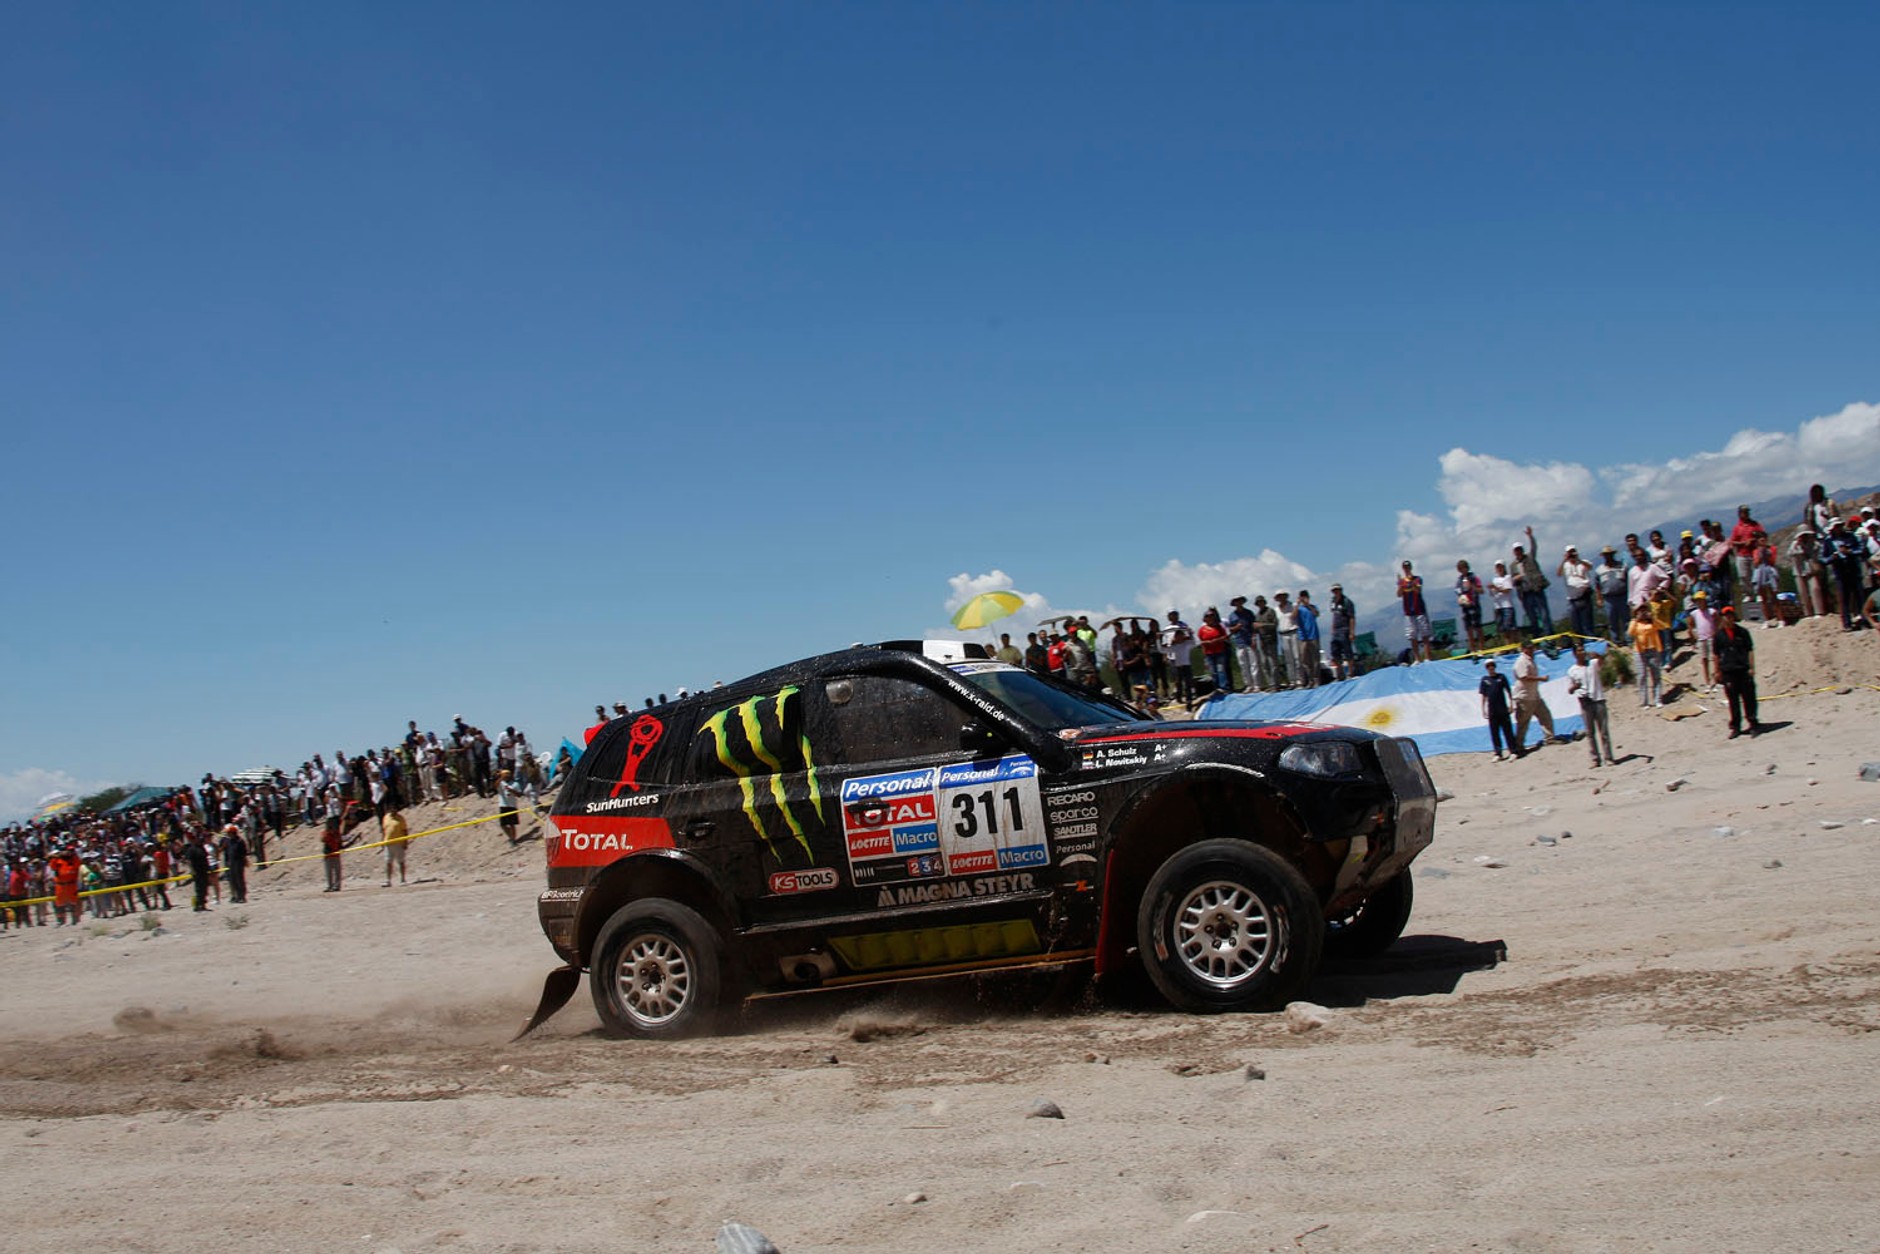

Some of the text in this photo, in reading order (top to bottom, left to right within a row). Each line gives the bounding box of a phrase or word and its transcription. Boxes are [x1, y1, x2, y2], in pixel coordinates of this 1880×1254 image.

[948, 680, 1005, 721] www.x-raid.de
[1096, 750, 1106, 759] A.
[1107, 747, 1137, 758] Schulz
[941, 764, 1001, 783] Personal
[845, 771, 933, 799] Personal
[586, 793, 660, 814] SunHunters
[1047, 791, 1096, 807] RECARO
[952, 786, 1024, 839] 311
[1050, 806, 1098, 824] sparco
[895, 831, 938, 846] Macro
[1054, 822, 1098, 837] SANDTLER
[561, 828, 634, 851] TOTAL
[850, 836, 891, 851] LOCTITE
[1056, 840, 1096, 854] Personal
[952, 854, 994, 869] LOCTITE
[1001, 849, 1045, 864] Macro
[775, 872, 834, 890] KS TOOLS
[897, 872, 1036, 905] MAGNA STEYR
